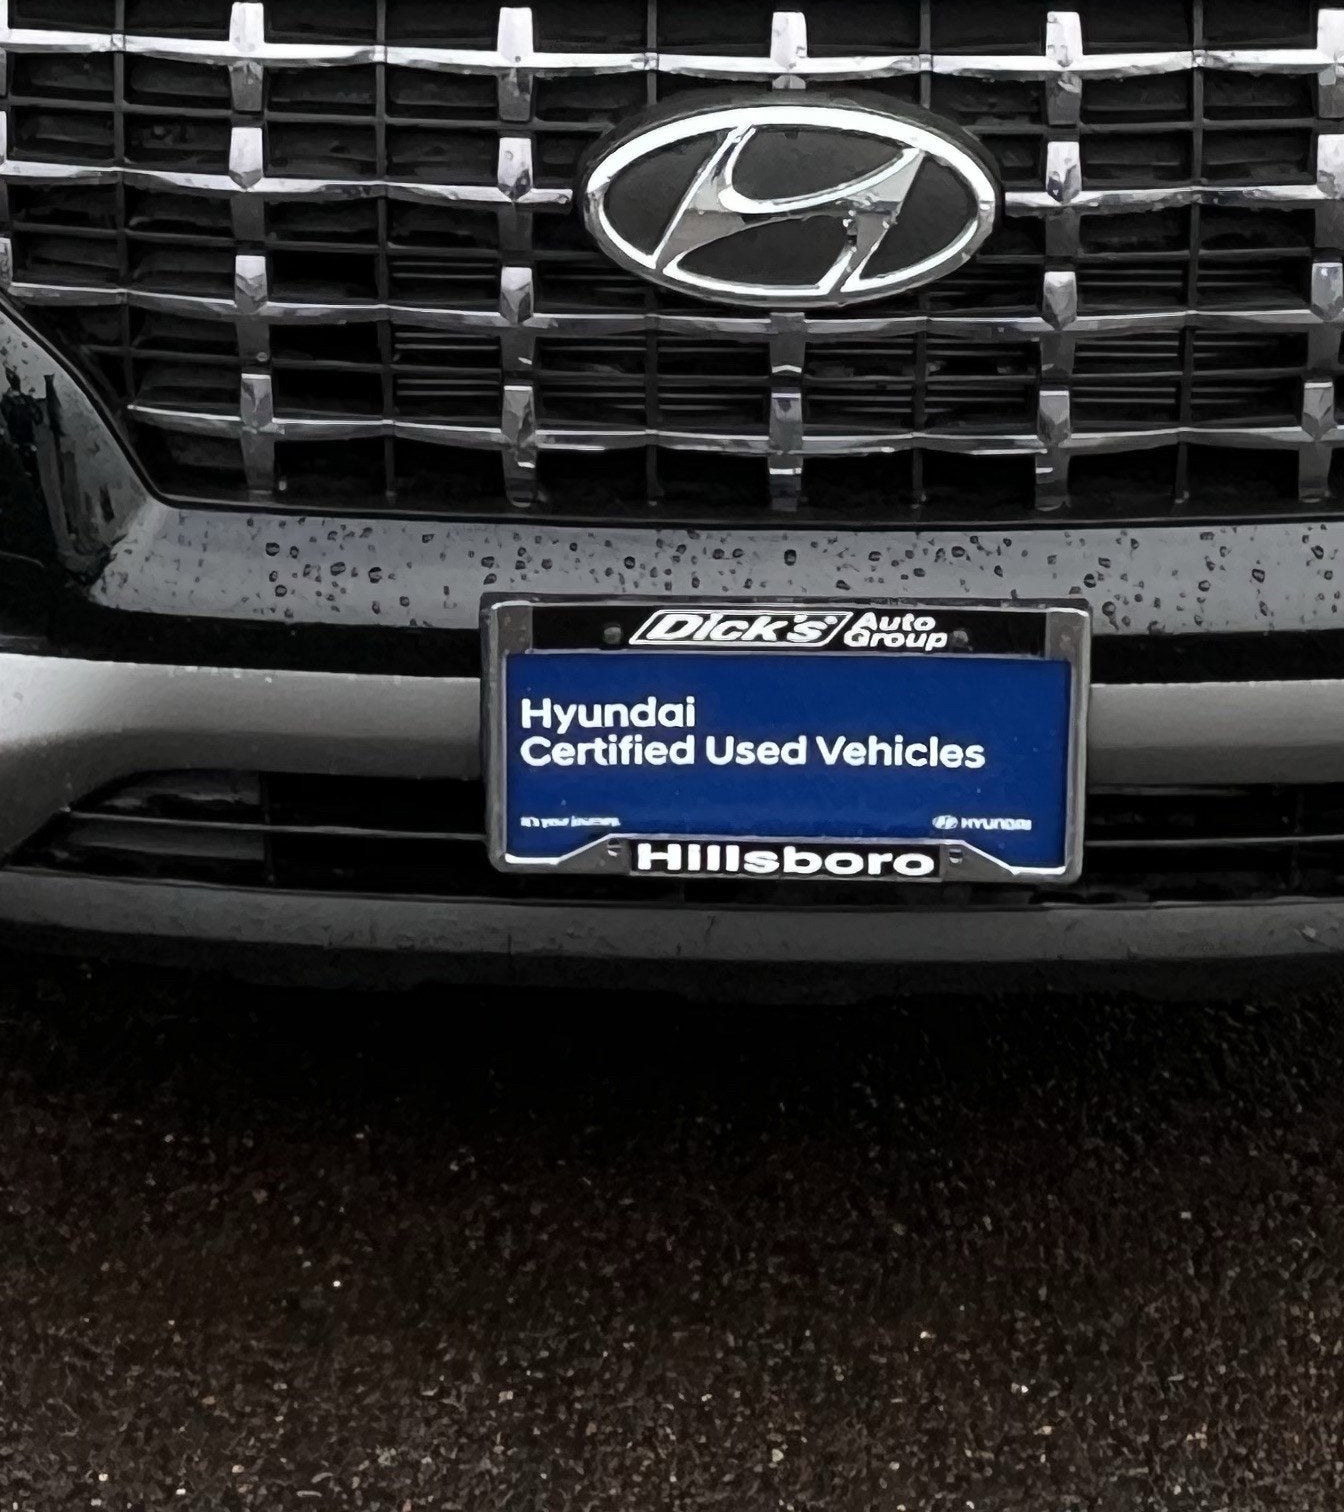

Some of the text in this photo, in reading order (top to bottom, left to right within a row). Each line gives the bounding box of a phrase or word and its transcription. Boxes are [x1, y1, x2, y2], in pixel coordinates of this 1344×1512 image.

[852, 611, 937, 631] Auto
[843, 628, 948, 651] Group
[521, 696, 696, 734] Hyundai
[520, 735, 986, 769] Certified Used Vehicles
[637, 843, 935, 876] Hillsboro
